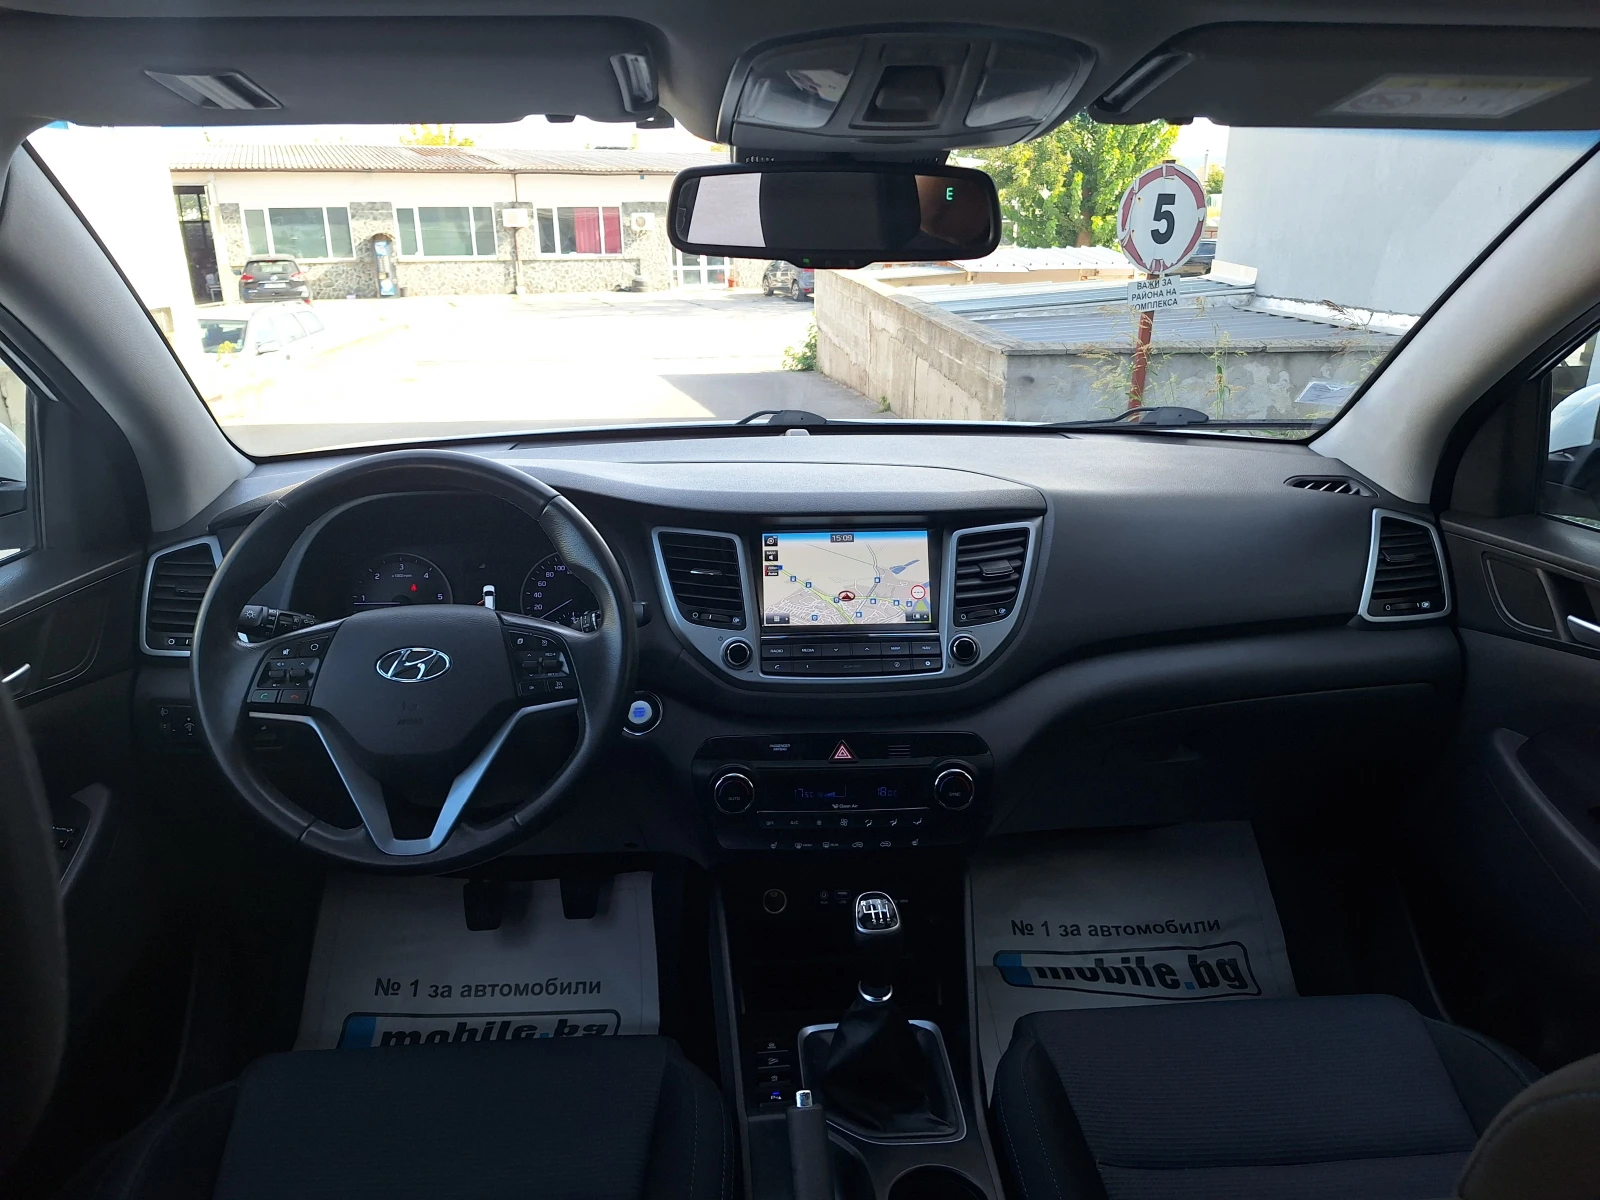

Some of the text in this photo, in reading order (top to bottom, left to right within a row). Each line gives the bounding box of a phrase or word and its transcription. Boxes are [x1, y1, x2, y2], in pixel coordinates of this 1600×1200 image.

[946, 187, 954, 201] E
[1150, 193, 1176, 245] 5
[1136, 278, 1173, 290] ВАЖИ ЗА
[1131, 288, 1177, 301] РАЙОНА НА
[399, 563, 405, 571] 3
[361, 594, 366, 602] 1
[1010, 919, 1221, 937] № 1 за автомобили
[373, 977, 602, 998] № 1 за автомобили
